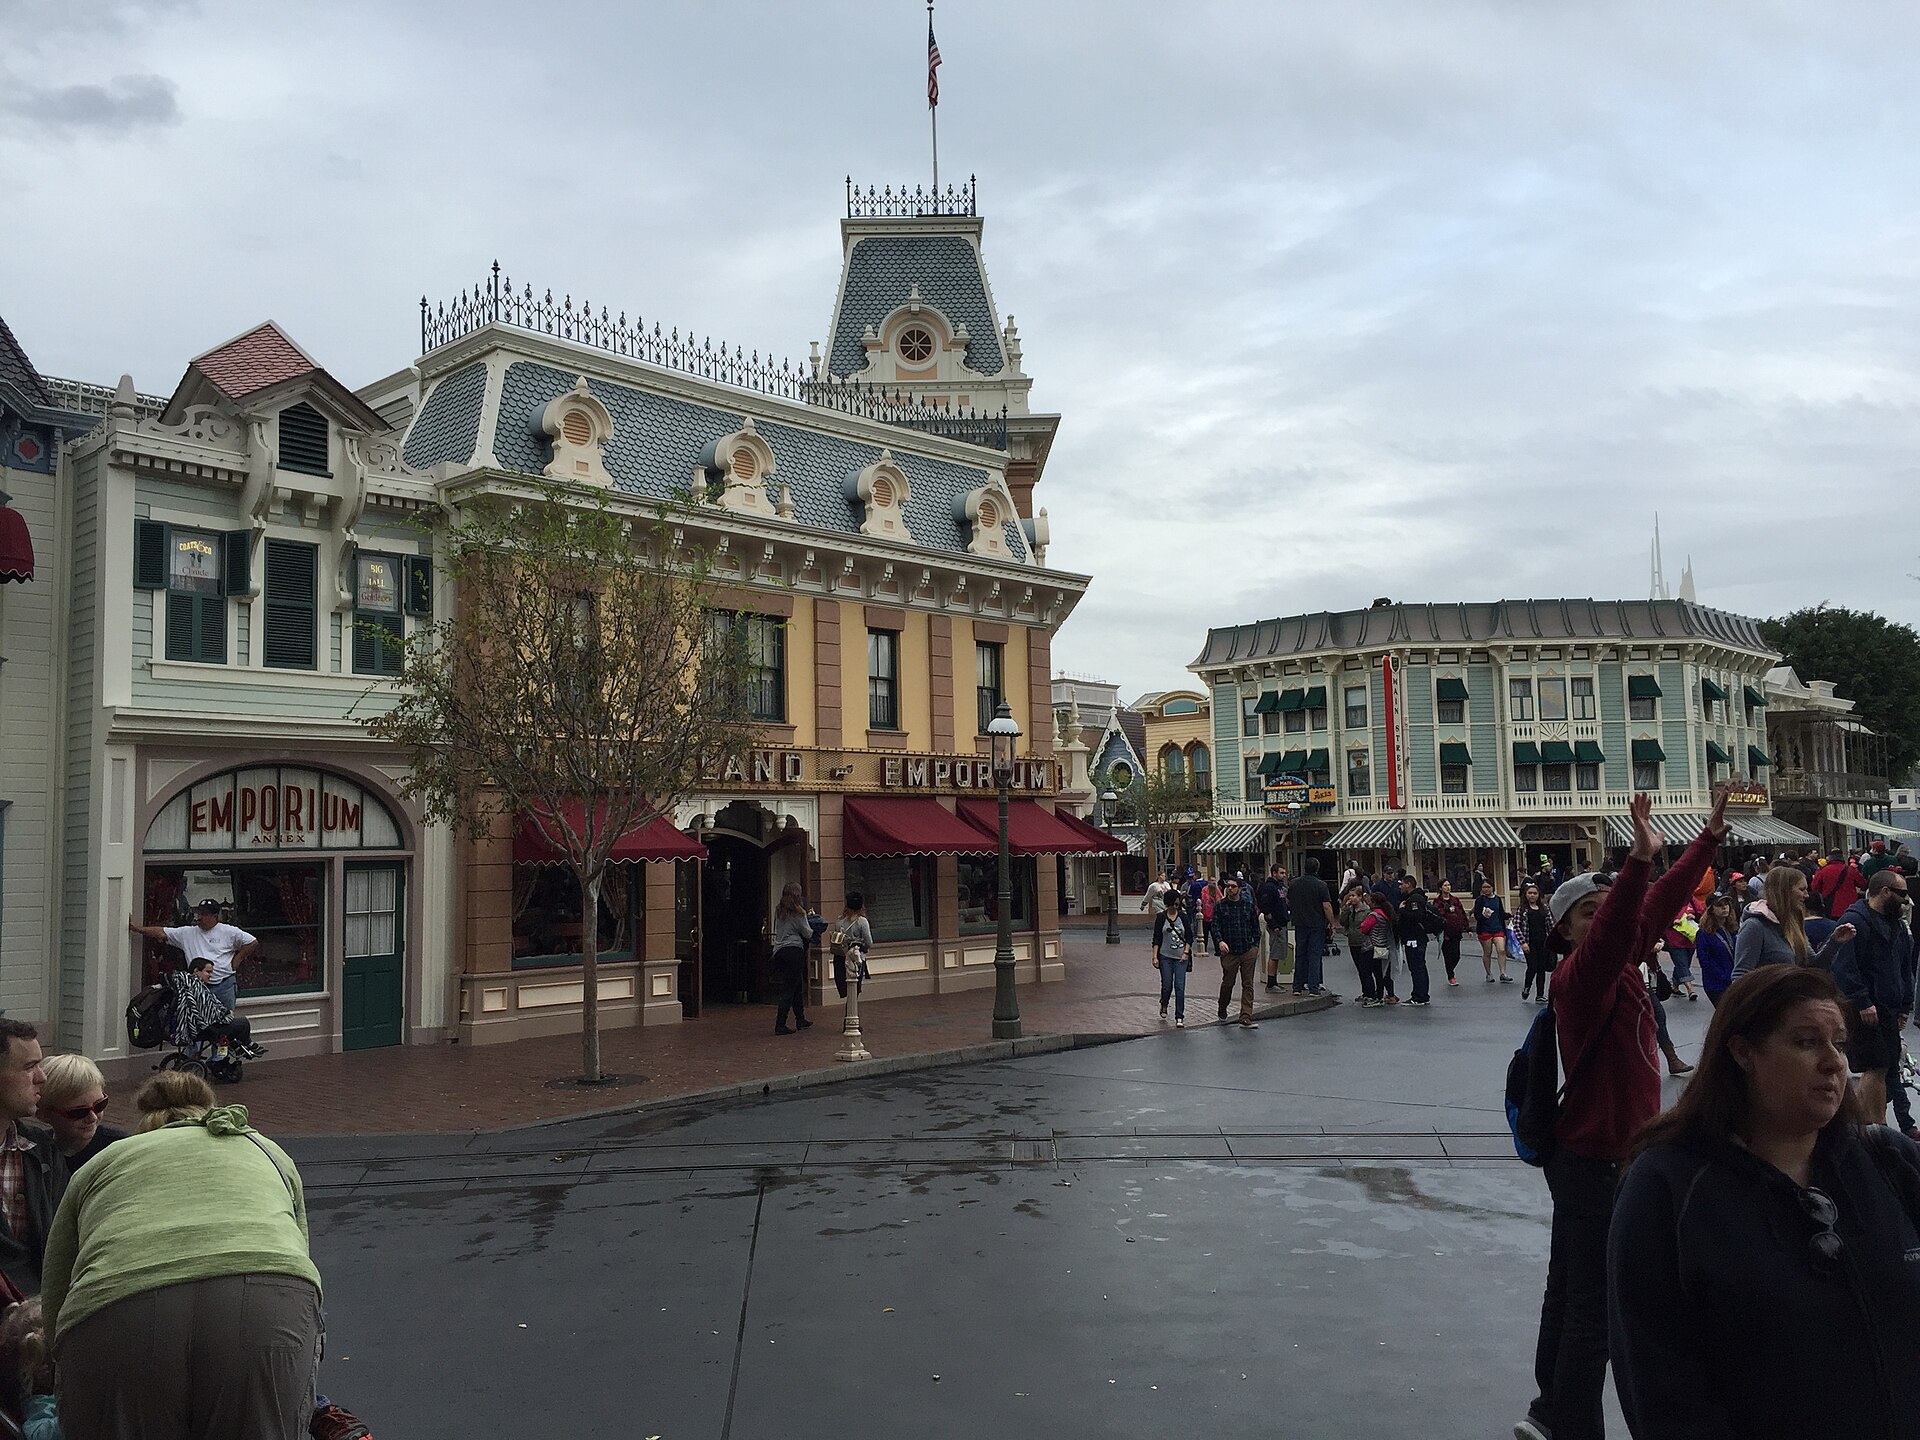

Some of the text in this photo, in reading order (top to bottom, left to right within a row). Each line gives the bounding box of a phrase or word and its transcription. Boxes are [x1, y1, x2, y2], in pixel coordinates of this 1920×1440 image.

[179, 541, 198, 551] COATS
[370, 564, 383, 574] BIG
[1391, 677, 1399, 715] MAIN
[1395, 724, 1403, 781] STREET
[880, 757, 1050, 789] EMPORUM
[191, 784, 361, 833] EMPORIUM
[251, 834, 306, 844] ANNEX
